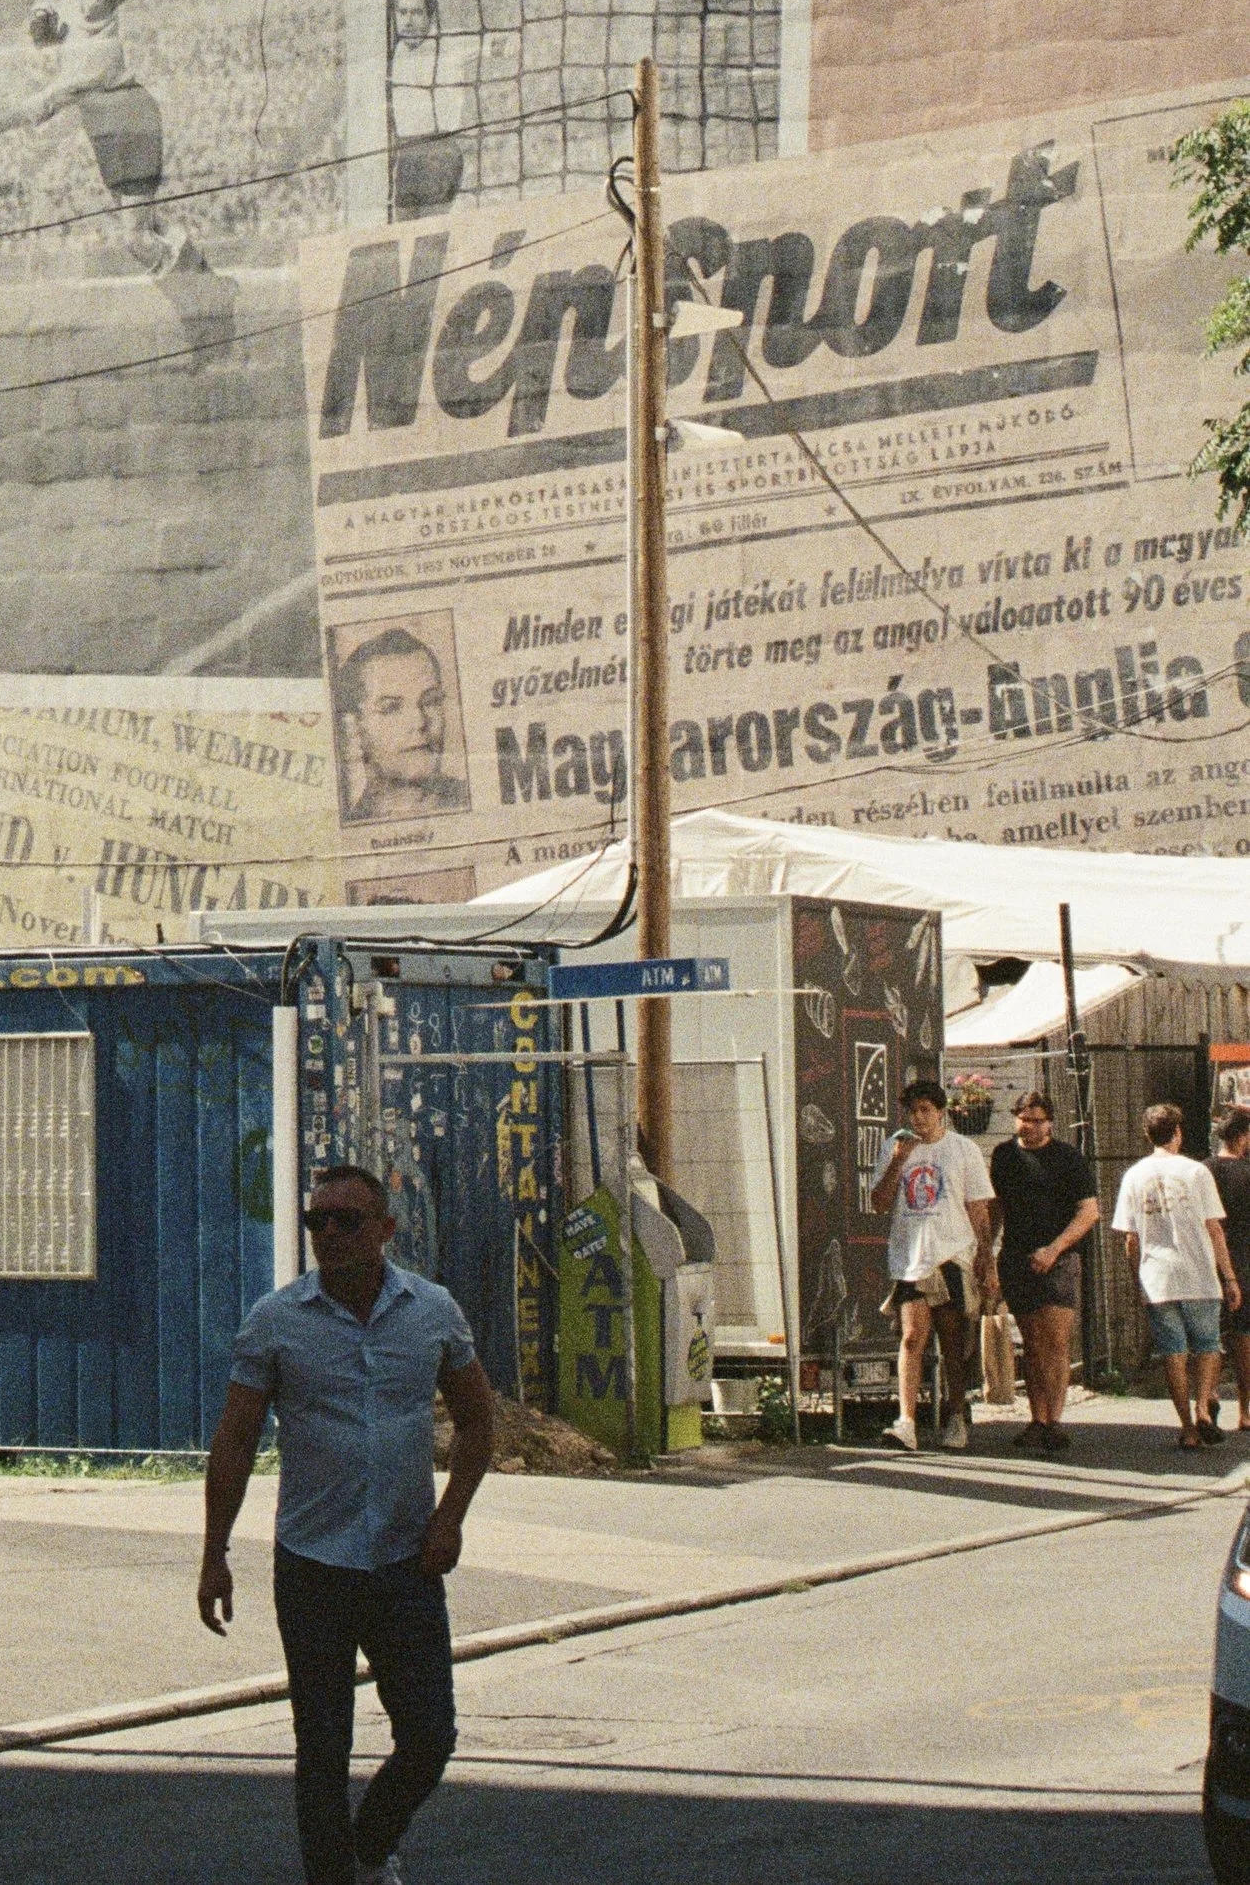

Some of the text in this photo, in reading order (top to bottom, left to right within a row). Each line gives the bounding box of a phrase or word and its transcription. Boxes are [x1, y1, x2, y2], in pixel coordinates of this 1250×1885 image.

[363, 502, 446, 526] MAGYAR
[455, 476, 627, 515] NÉPKÖZTÁRSASÁ
[419, 509, 533, 538] ORSZÁGOS
[930, 440, 998, 462] LAPJA
[449, 545, 537, 570] NOVEMBER
[502, 607, 604, 654] Minden
[703, 579, 808, 631] játékát
[977, 548, 1051, 585] vívta
[1063, 535, 1093, 573] ki
[1104, 544, 1122, 567] a
[684, 643, 754, 675] törte
[765, 633, 824, 666] meg
[834, 627, 865, 656] az
[872, 603, 950, 653] angol
[958, 586, 1113, 638] válogatott
[1121, 573, 1167, 614] 90
[1173, 570, 1243, 608] éves
[494, 640, 1211, 806] Magarország-Anglia
[113, 762, 240, 815] FOOTBALL
[851, 789, 970, 824] részében
[1146, 766, 1176, 788] az
[150, 810, 236, 848] MATCH
[1000, 806, 1122, 845] amellyel
[505, 840, 523, 866] A
[641, 965, 675, 988] ATM
[577, 1254, 631, 1401] ATM
